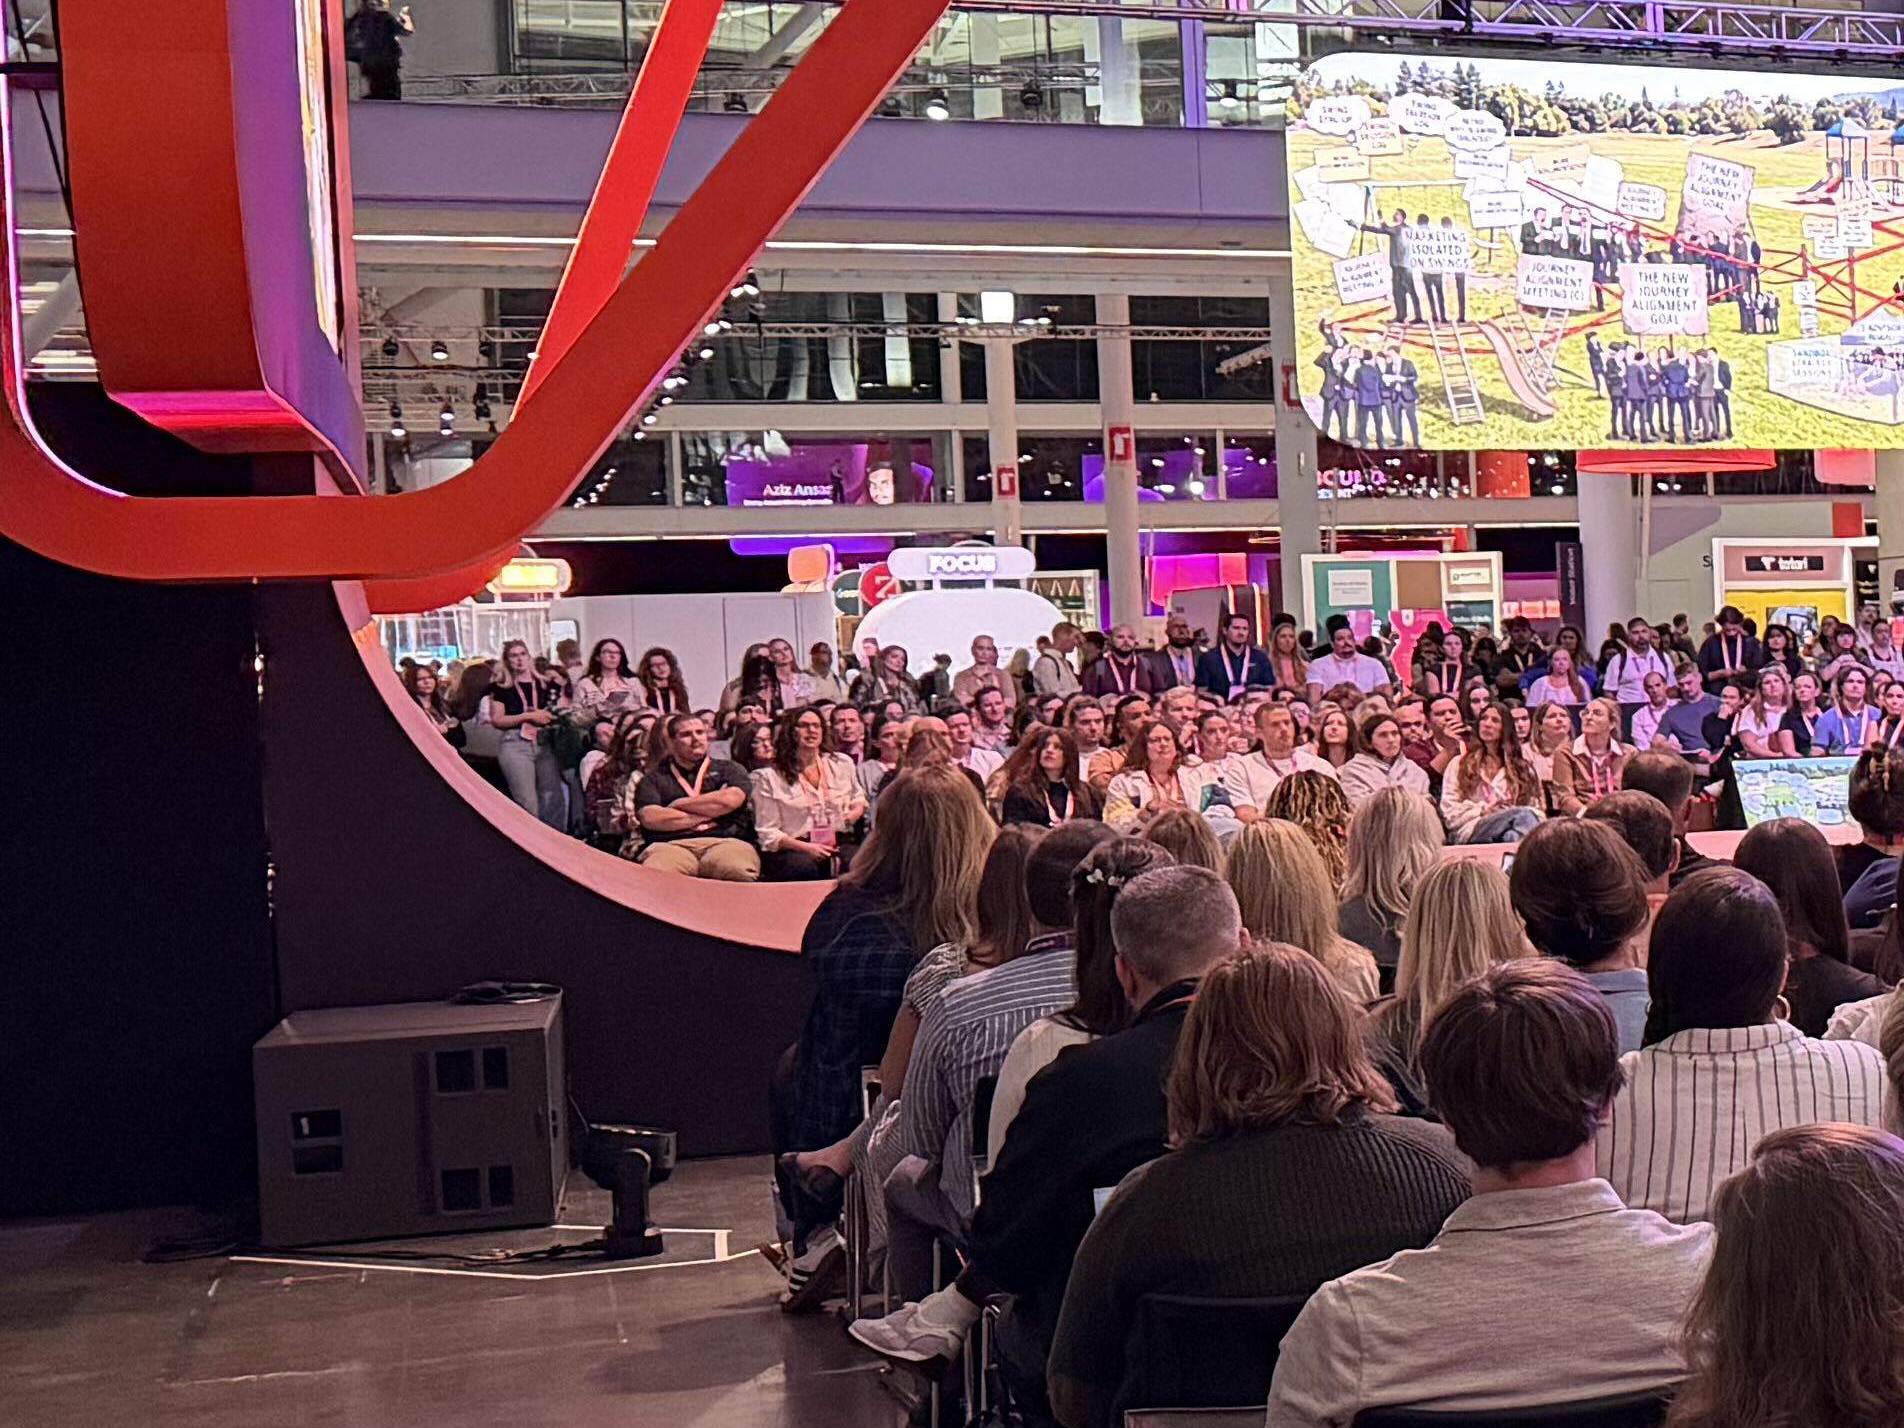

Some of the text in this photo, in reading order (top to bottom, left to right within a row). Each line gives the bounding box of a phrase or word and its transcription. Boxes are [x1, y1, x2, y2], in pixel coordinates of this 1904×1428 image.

[1405, 230, 1467, 243] MARKETING
[1410, 244, 1463, 256] ISOLATED
[1410, 257, 1424, 268] ON
[1532, 263, 1577, 273] JOURNEY
[1525, 274, 1582, 288] ALIGNMENT
[1638, 272, 1690, 284] THE NEW
[1523, 286, 1568, 300] MEETING
[1639, 286, 1690, 298] JOURNEY
[1631, 300, 1697, 311] ALIGNMENT
[1650, 313, 1681, 325] GOAL
[763, 483, 792, 496] Aziz
[928, 554, 996, 573] FOCUS
